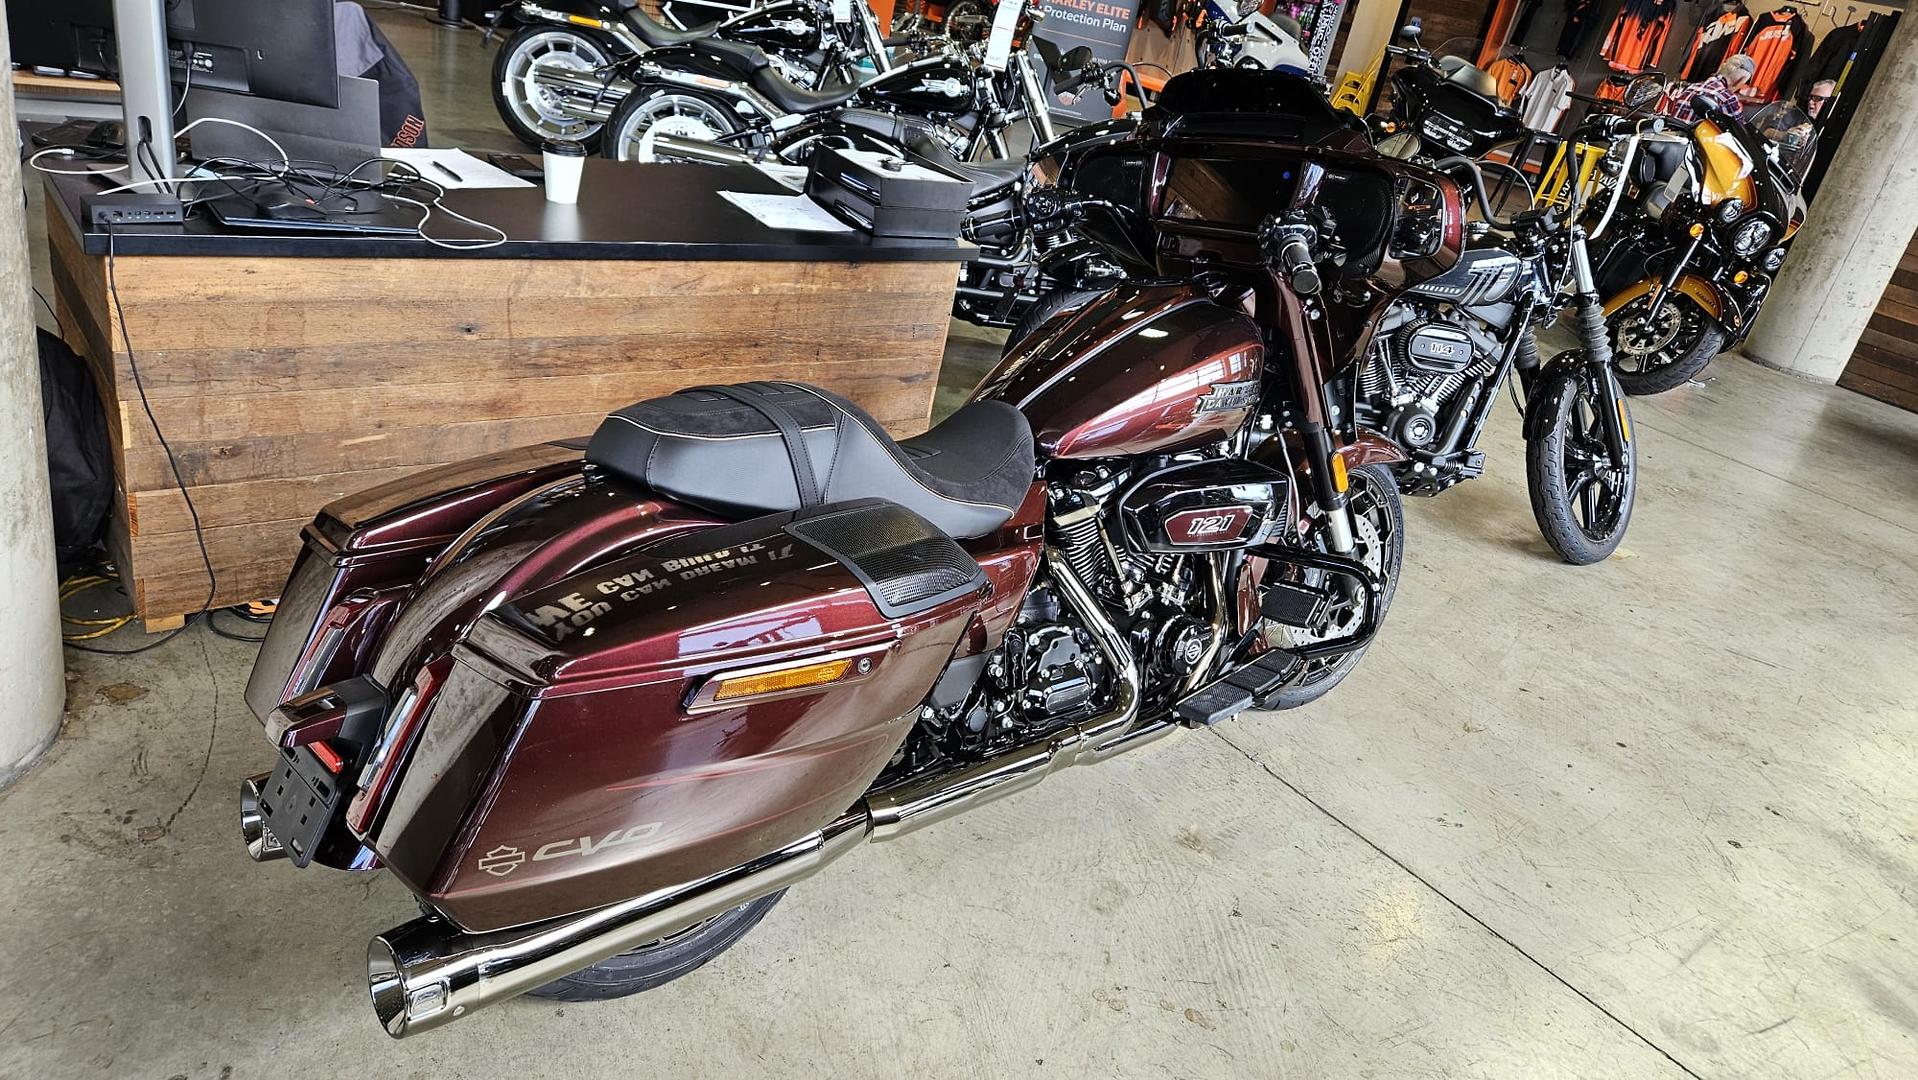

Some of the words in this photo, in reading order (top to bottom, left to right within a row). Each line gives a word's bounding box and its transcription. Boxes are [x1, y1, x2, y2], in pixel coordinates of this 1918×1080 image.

[1043, 5, 1101, 27] Protection
[1102, 19, 1127, 33] Plan
[1047, 0, 1096, 12] ARLEY
[1096, 4, 1131, 20] ELITE
[1430, 342, 1454, 354] 114
[1187, 515, 1235, 535] 121
[532, 821, 664, 861] CVO
